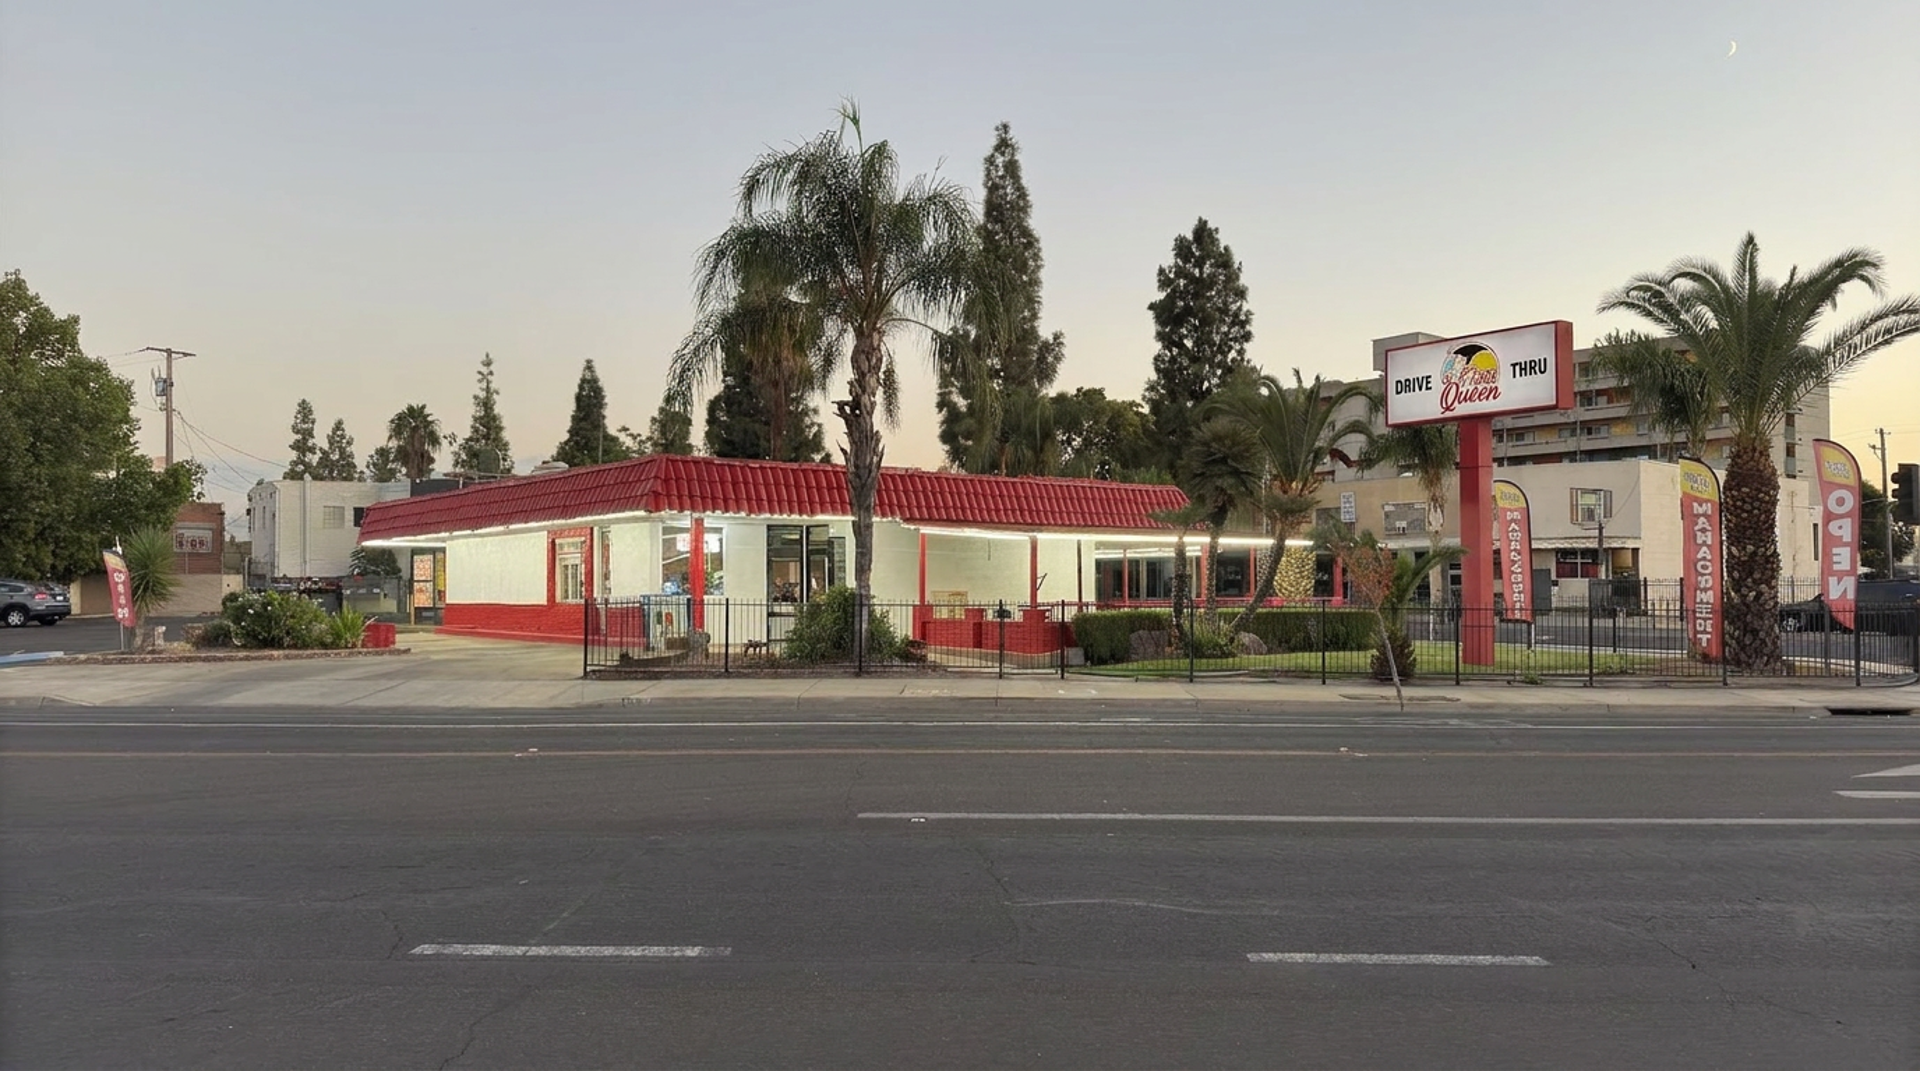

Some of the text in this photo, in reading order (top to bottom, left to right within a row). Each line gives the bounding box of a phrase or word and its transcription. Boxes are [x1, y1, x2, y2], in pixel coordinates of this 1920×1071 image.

[1510, 358, 1547, 379] THRU
[1395, 375, 1432, 395] DRIVE
[1440, 382, 1501, 415] Queen
